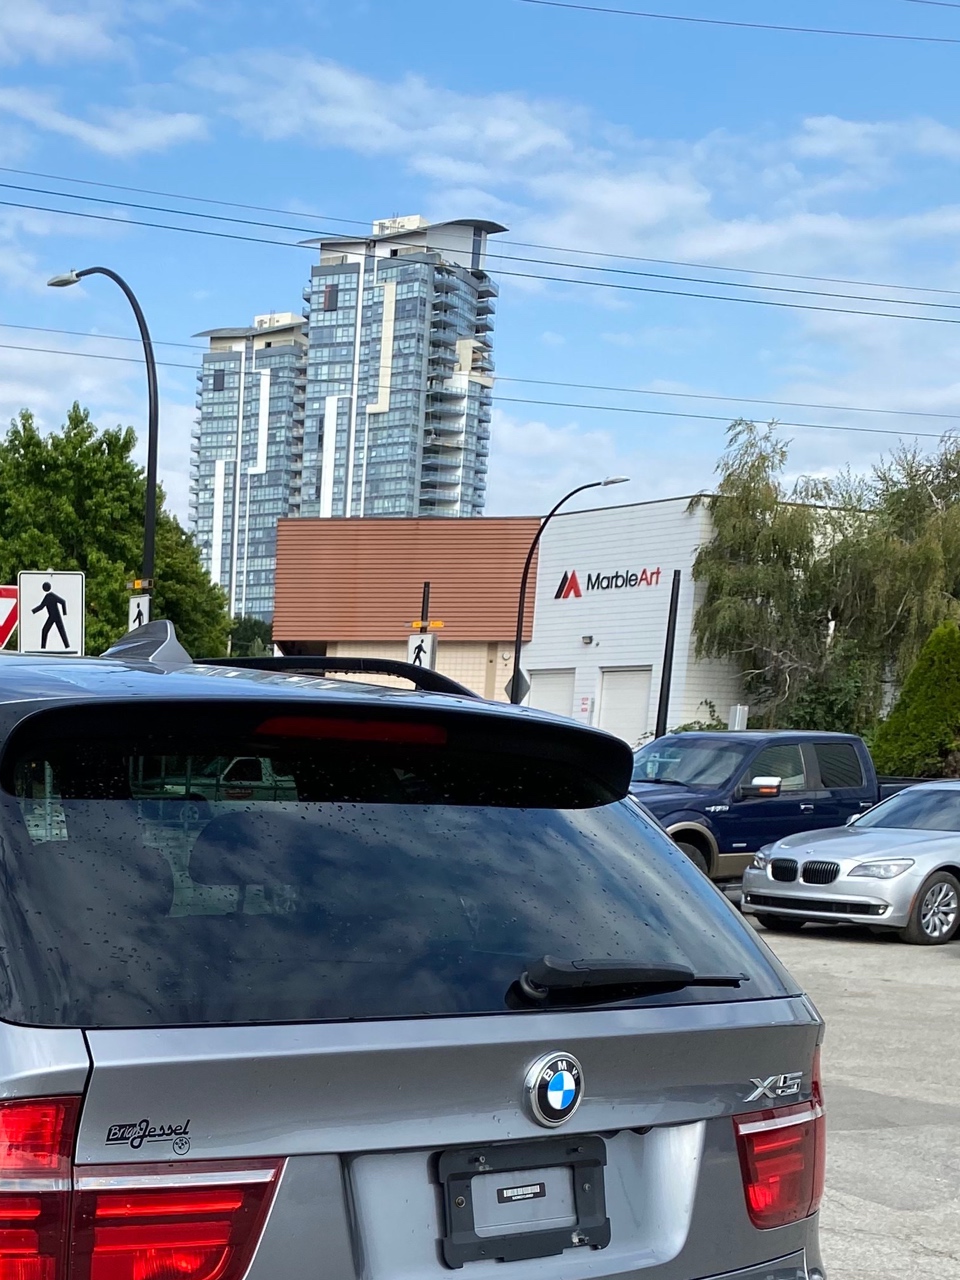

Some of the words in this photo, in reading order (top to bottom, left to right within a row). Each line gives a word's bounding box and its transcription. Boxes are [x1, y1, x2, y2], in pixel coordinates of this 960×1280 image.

[586, 567, 661, 591] MarbleArt
[543, 1060, 580, 1081] BMW
[742, 1071, 803, 1103] X5
[108, 1125, 141, 1141] Brian
[129, 1119, 191, 1149] Jessel
